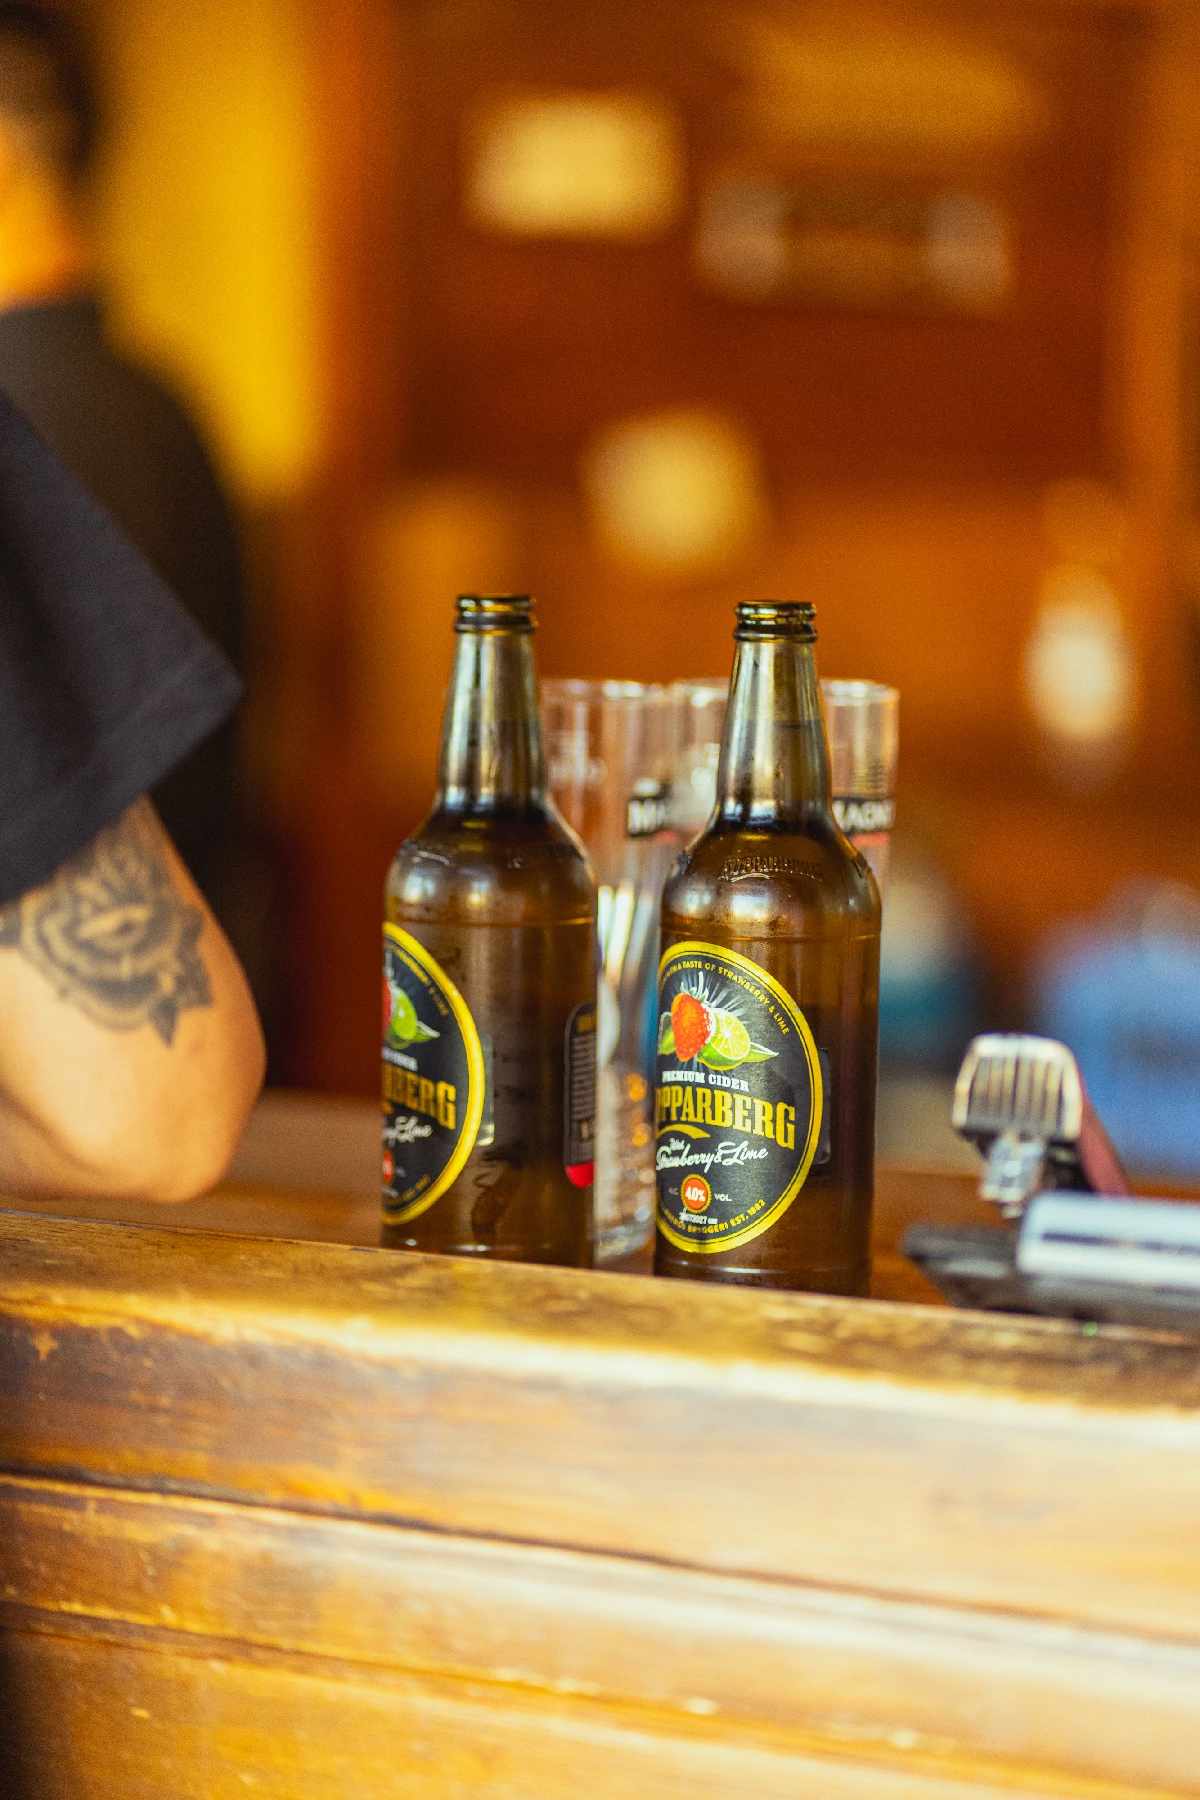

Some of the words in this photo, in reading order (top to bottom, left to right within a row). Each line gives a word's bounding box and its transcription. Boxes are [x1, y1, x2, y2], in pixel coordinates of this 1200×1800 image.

[682, 960, 703, 969] TASTE
[704, 962, 716, 971] OF
[718, 966, 771, 1005] STRAWBERRY
[768, 1005, 775, 1014] &
[773, 1012, 790, 1035] LIME
[662, 1070, 706, 1083] PREMIUM
[708, 1073, 750, 1092] CIDER
[729, 1213, 749, 1227] EST.
